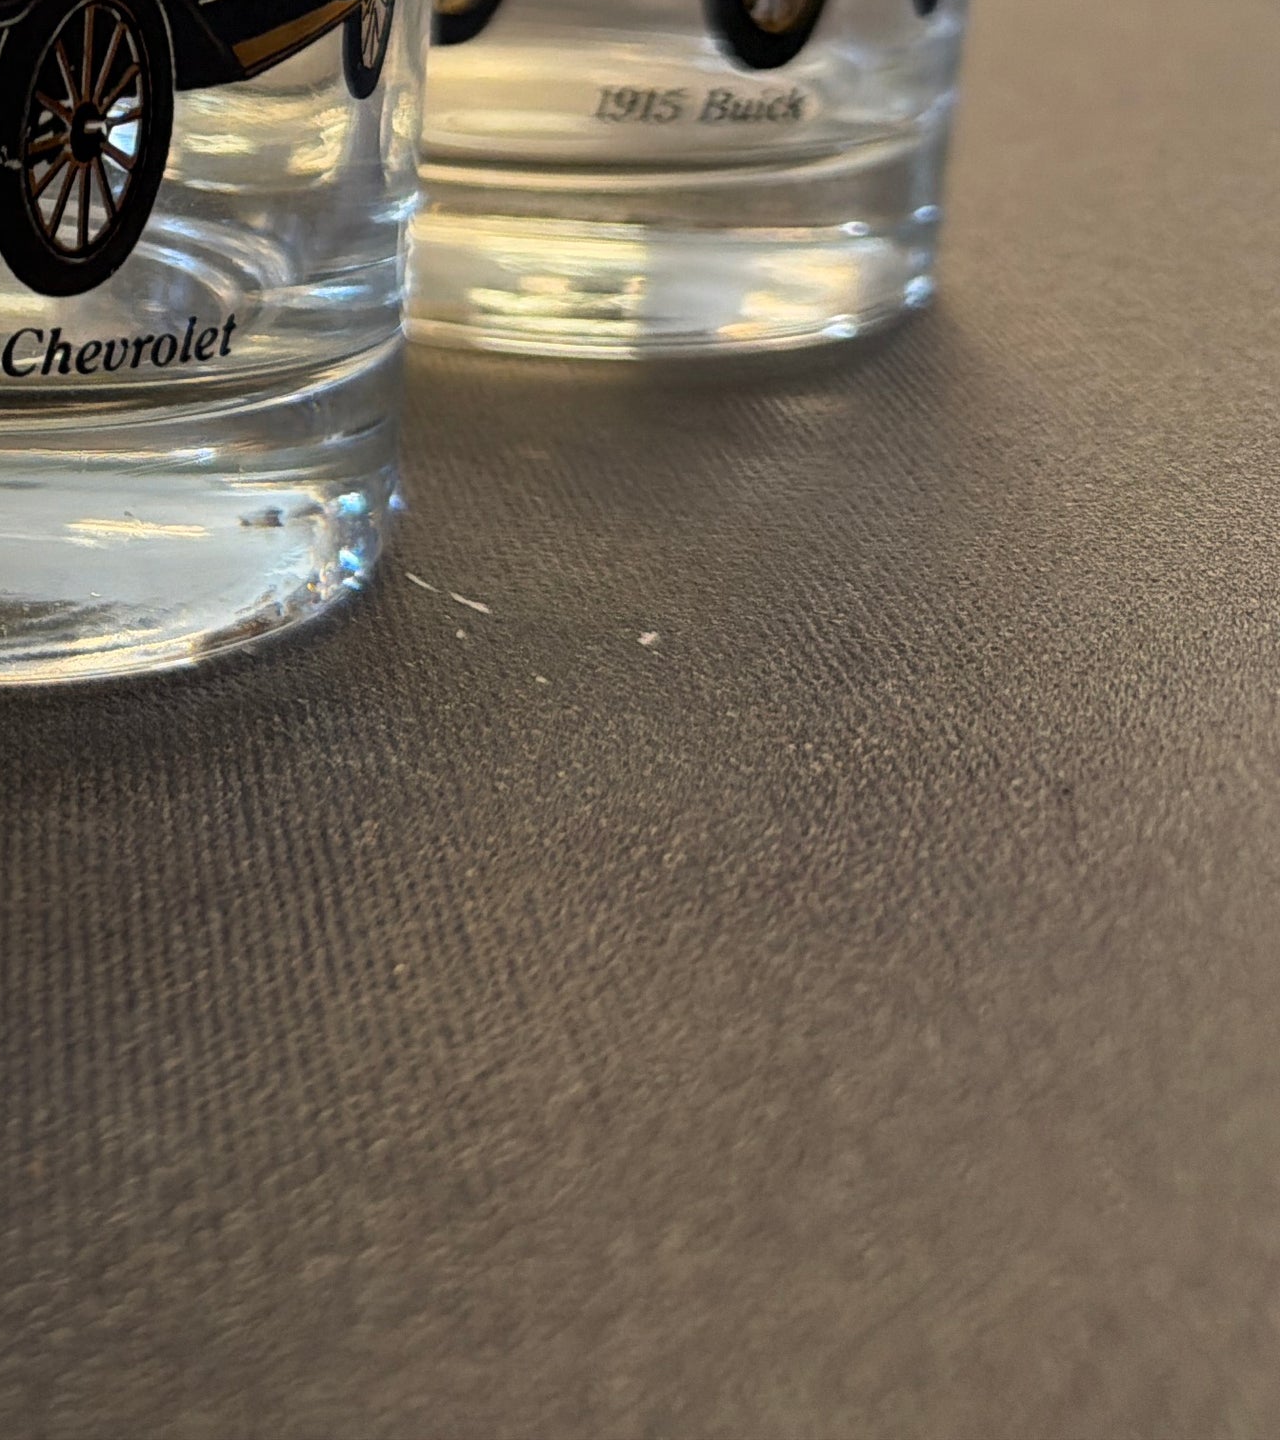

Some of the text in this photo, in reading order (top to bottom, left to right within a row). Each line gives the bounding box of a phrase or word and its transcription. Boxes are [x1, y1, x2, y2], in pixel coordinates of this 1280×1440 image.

[594, 86, 806, 124] 1915 Buick
[1, 314, 237, 378] Chevrolet
